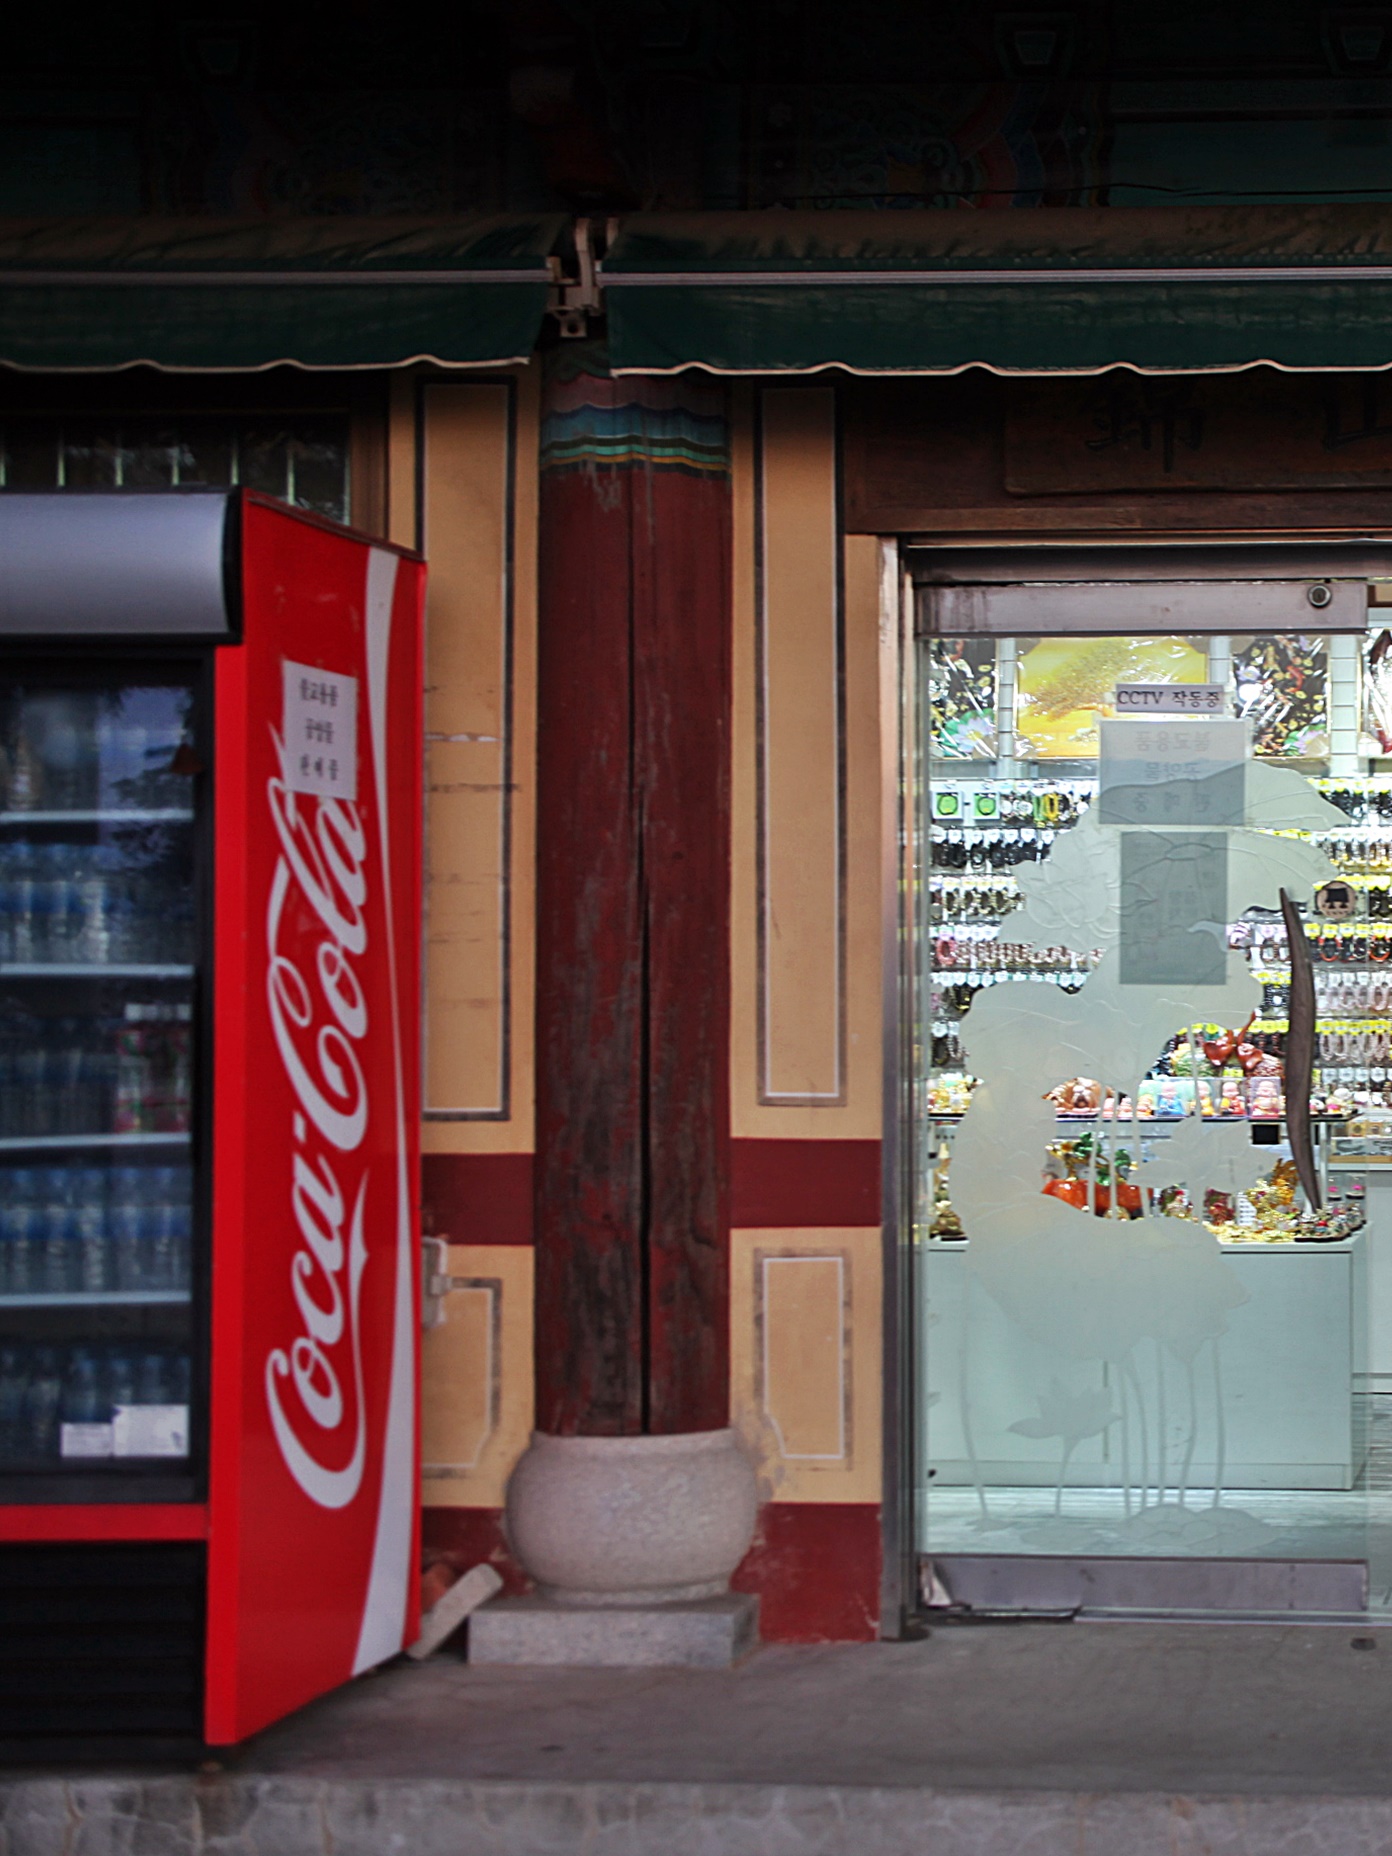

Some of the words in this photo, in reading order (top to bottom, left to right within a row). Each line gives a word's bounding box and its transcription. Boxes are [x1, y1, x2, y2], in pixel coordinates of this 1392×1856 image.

[1116, 690, 1164, 704] CCTV
[1172, 690, 1220, 708] 작동중
[266, 723, 370, 1509] Coca-Cola
